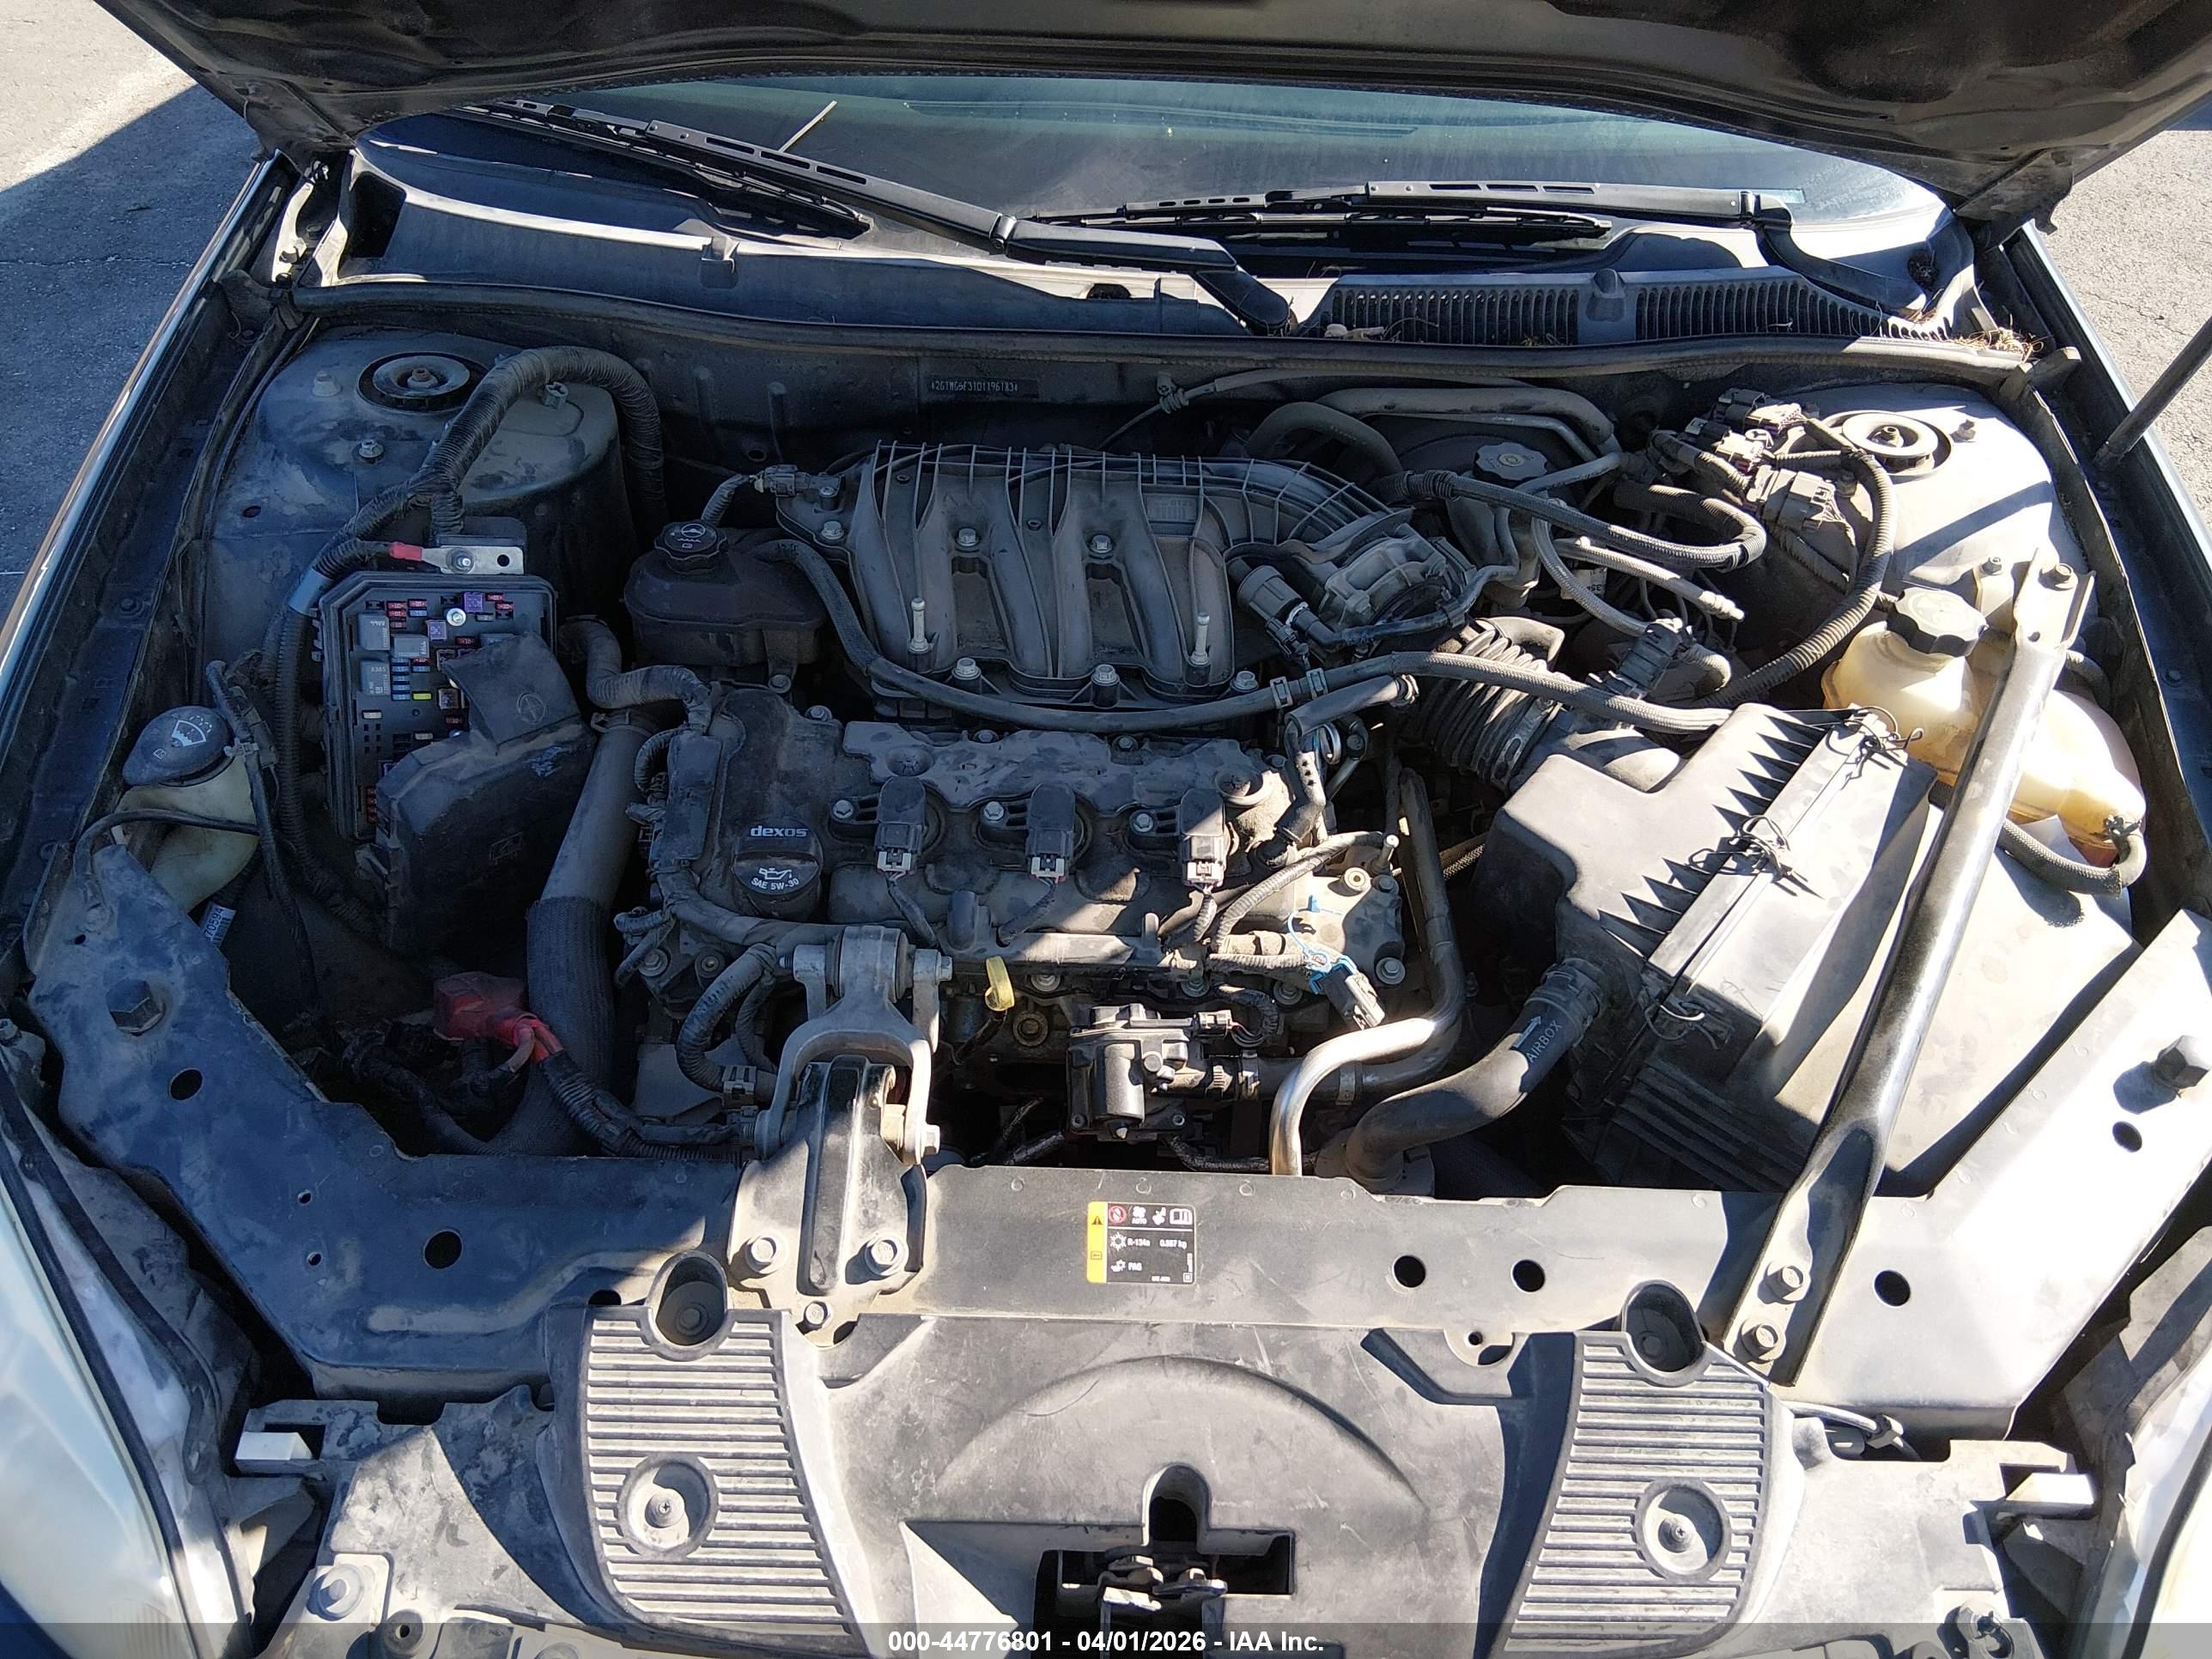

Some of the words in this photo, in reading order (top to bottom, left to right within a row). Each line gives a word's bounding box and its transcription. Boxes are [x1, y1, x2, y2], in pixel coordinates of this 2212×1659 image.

[750, 824, 810, 838] dexos
[750, 877, 769, 890] SAE
[769, 878, 799, 891] 5W-30
[1526, 1020, 1563, 1064] AIRBOX
[1127, 1237, 1150, 1246] R-134a
